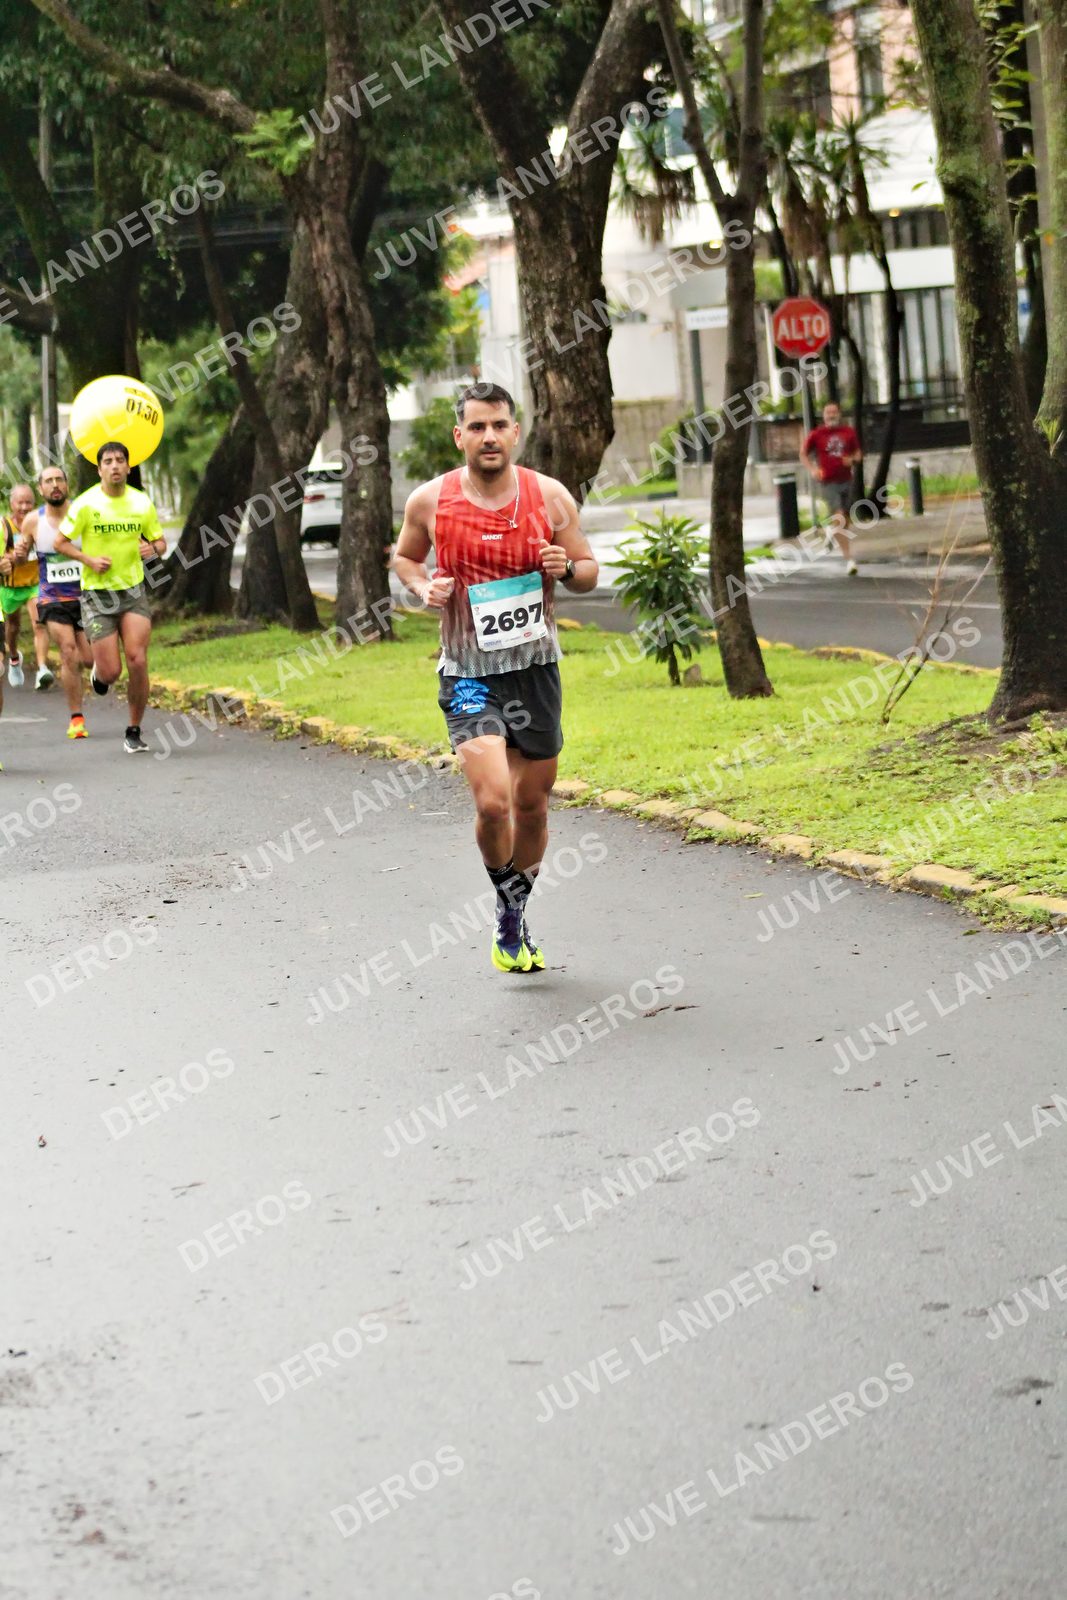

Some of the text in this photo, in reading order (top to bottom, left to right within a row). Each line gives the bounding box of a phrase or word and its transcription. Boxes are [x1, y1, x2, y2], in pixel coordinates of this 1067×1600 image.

[777, 315, 826, 341] ALTO
[126, 398, 159, 426] 01:30
[51, 567, 80, 577] 1601
[480, 602, 542, 635] 2697
